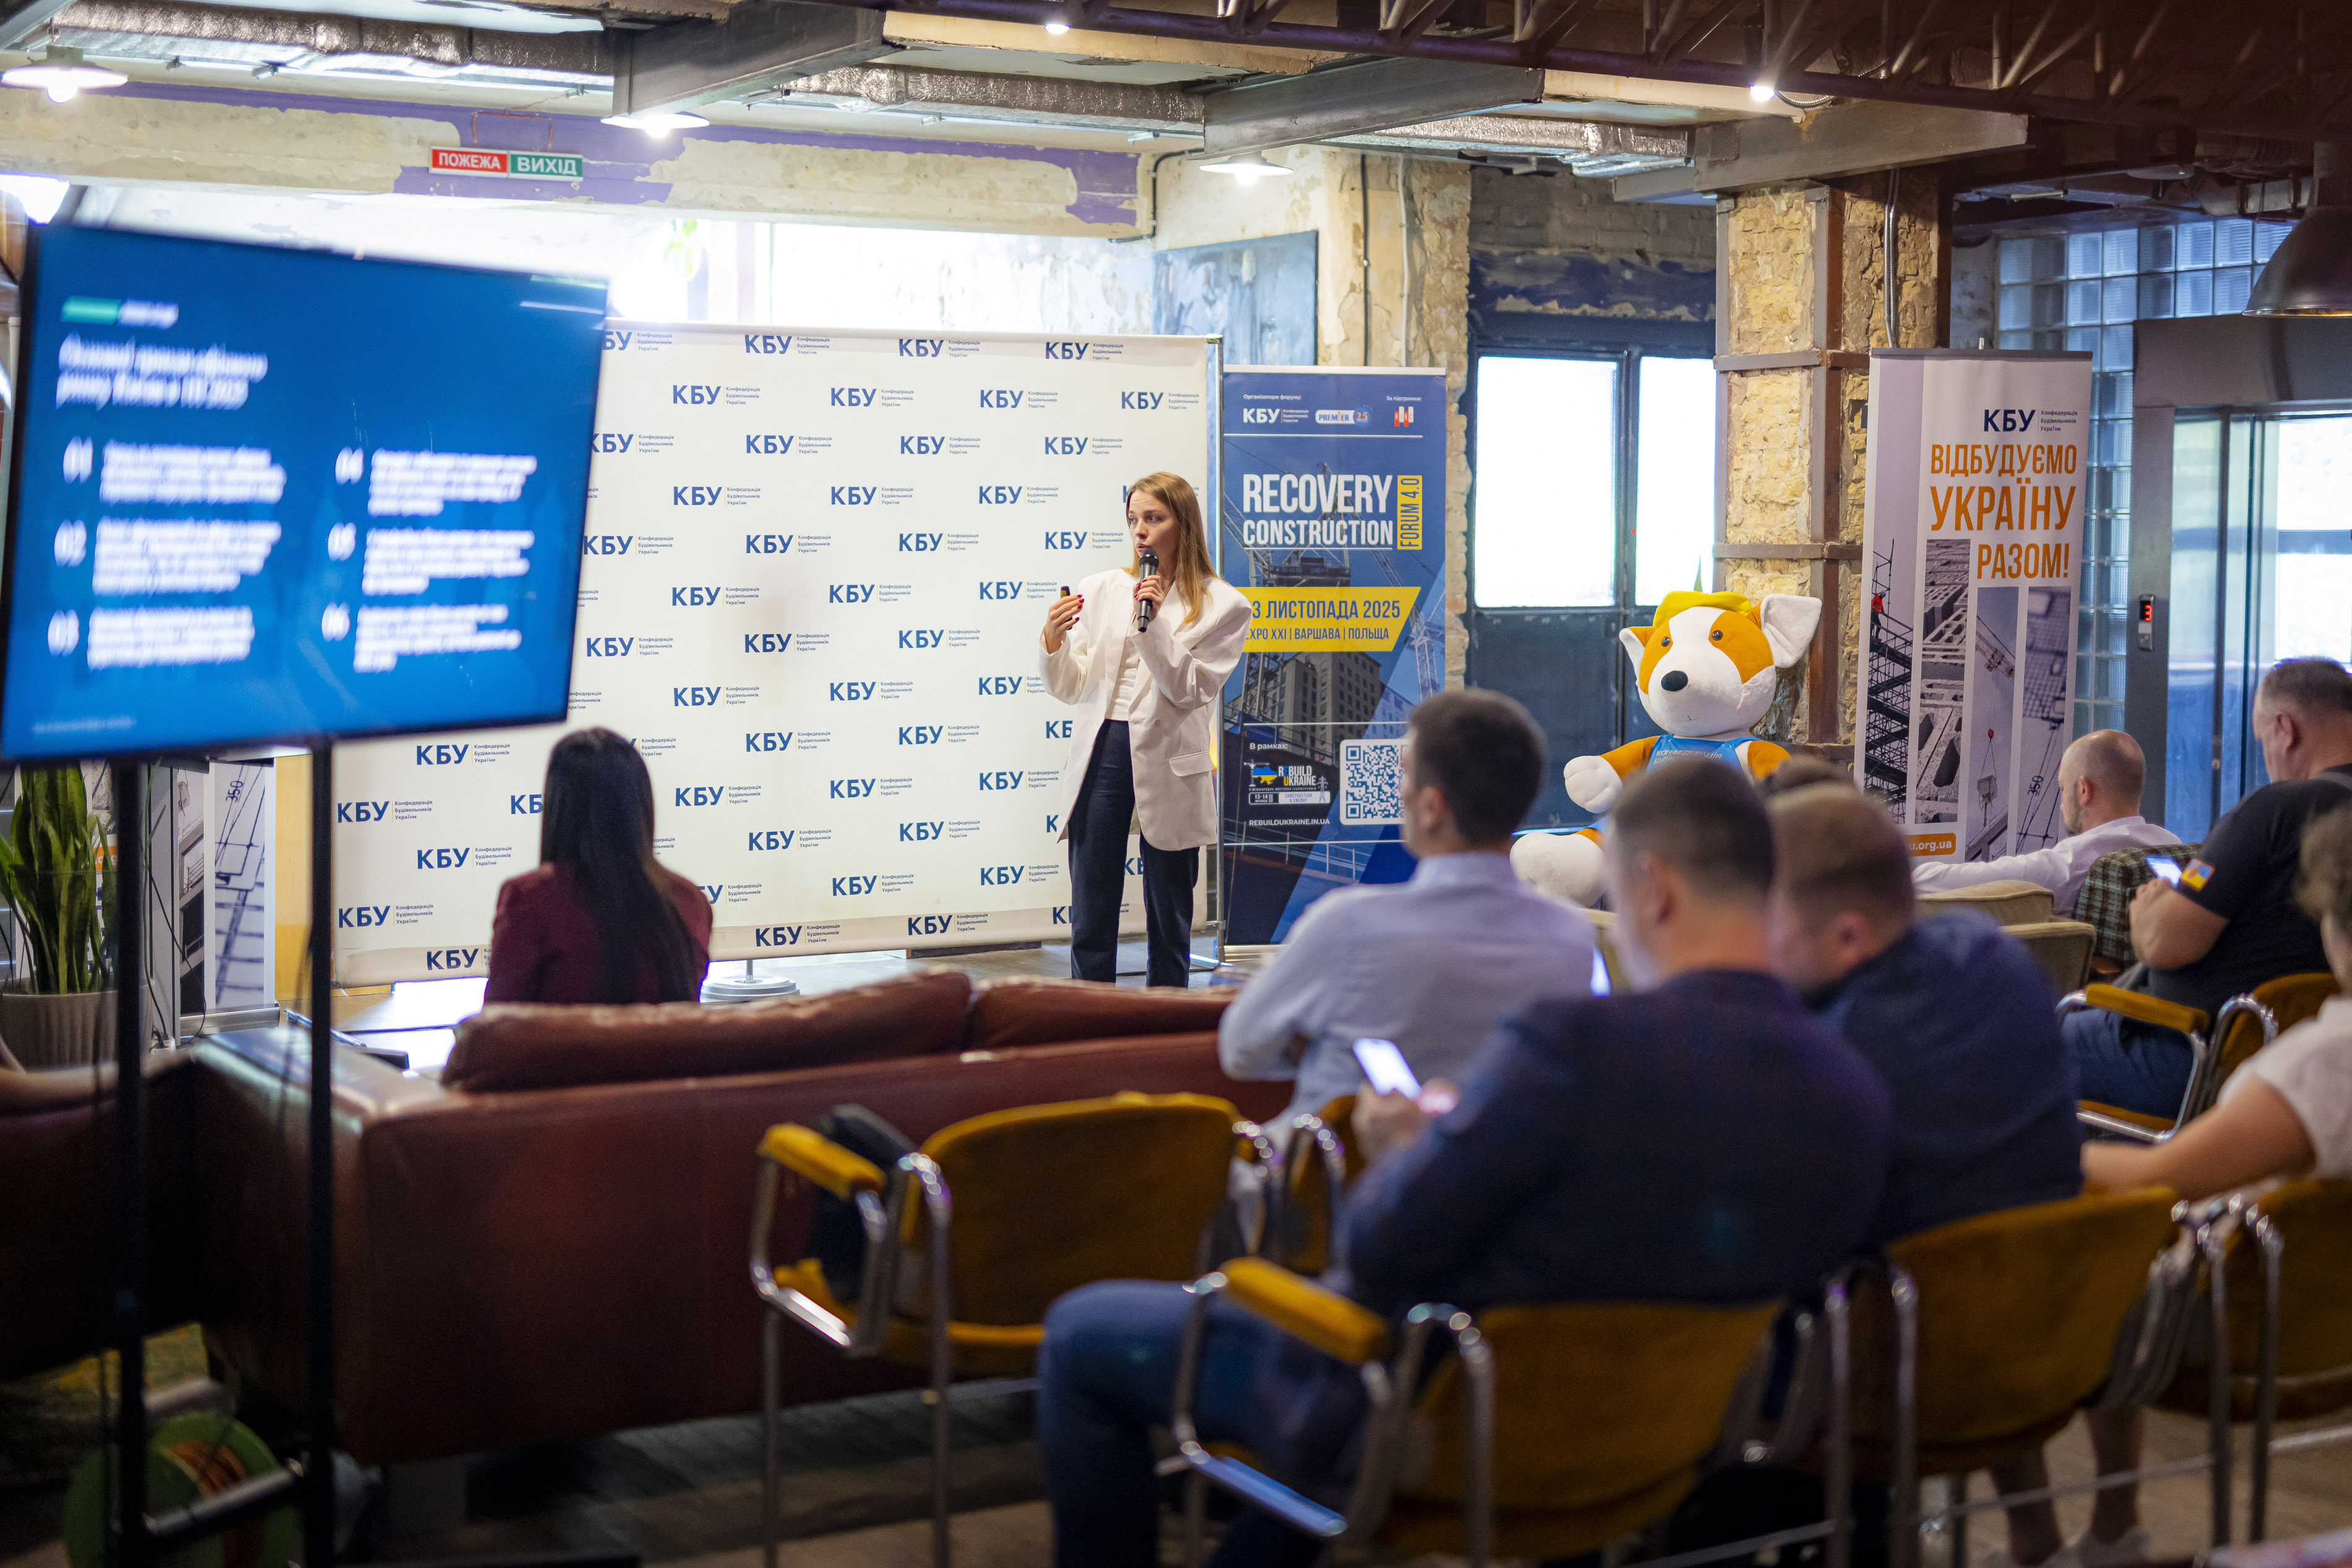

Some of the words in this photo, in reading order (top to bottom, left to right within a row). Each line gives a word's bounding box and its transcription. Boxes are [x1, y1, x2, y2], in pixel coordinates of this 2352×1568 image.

[438, 152, 501, 170] ПОЖЕЖА
[517, 157, 577, 176] ВИХІД
[745, 334, 792, 355] КБУ
[899, 338, 945, 358] КБУ
[1045, 342, 1090, 360] КБУ
[673, 385, 722, 405] КБУ
[831, 387, 877, 407] КБУ
[980, 389, 1024, 408] КБУ
[1122, 391, 1164, 410] КБУ
[1243, 408, 1281, 423] КБУ
[1984, 409, 2036, 432] КБУ
[746, 434, 794, 454] КБУ
[901, 436, 945, 455] КБУ
[1045, 436, 1089, 455] КБУ
[1930, 444, 2077, 477] ВІДБУДУЄМО
[673, 486, 723, 506] КБУ
[831, 486, 877, 506] КБУ
[979, 486, 1023, 504] КБУ
[1243, 473, 1393, 513] RECOVERY
[1399, 478, 1420, 499] 4.0
[1930, 477, 2077, 532] УКРАЇНУ
[1243, 519, 1393, 546] CONSTRUCTION
[1399, 503, 1420, 548] FORUM
[584, 535, 634, 555] КБУ
[746, 535, 793, 554] КБУ
[899, 533, 943, 552] КБУ
[1045, 532, 1087, 549] КБУ
[1977, 543, 2070, 579] РАЗОМ!
[672, 587, 721, 606] КБУ
[829, 584, 875, 603] КБУ
[979, 581, 1023, 600] КБУ
[1266, 600, 1359, 620] ЛИСТОПАДА
[1363, 600, 1401, 618] 2025
[2144, 605, 2153, 622] 3
[745, 633, 792, 653] КБУ
[898, 629, 945, 649] КБУ
[1294, 627, 1341, 640] ВАРШАВА
[1348, 627, 1390, 640] ПОЛЬЩА
[586, 637, 634, 657] КБУ
[829, 681, 876, 701] КБУ
[979, 676, 1023, 696] КБУ
[673, 686, 722, 707] КБУ
[746, 731, 793, 752] КБУ
[899, 725, 944, 745] КБУ
[417, 744, 469, 765] КБУ
[979, 770, 1024, 791] КБУ
[1278, 765, 1312, 777] REBUILD
[1284, 776, 1317, 786] UKRAINE
[675, 786, 724, 807] КБУ
[830, 778, 876, 799] КБУ
[337, 801, 390, 824] КБУ
[748, 830, 795, 851] КБУ
[899, 821, 945, 842] КБУ
[417, 847, 470, 869] КБУ
[980, 865, 1025, 886] КБУ
[832, 875, 878, 897] КБУ
[339, 905, 391, 928] КБУ
[907, 915, 953, 936] КБУ
[755, 925, 803, 947] КБУ
[426, 948, 479, 971] КБУ
